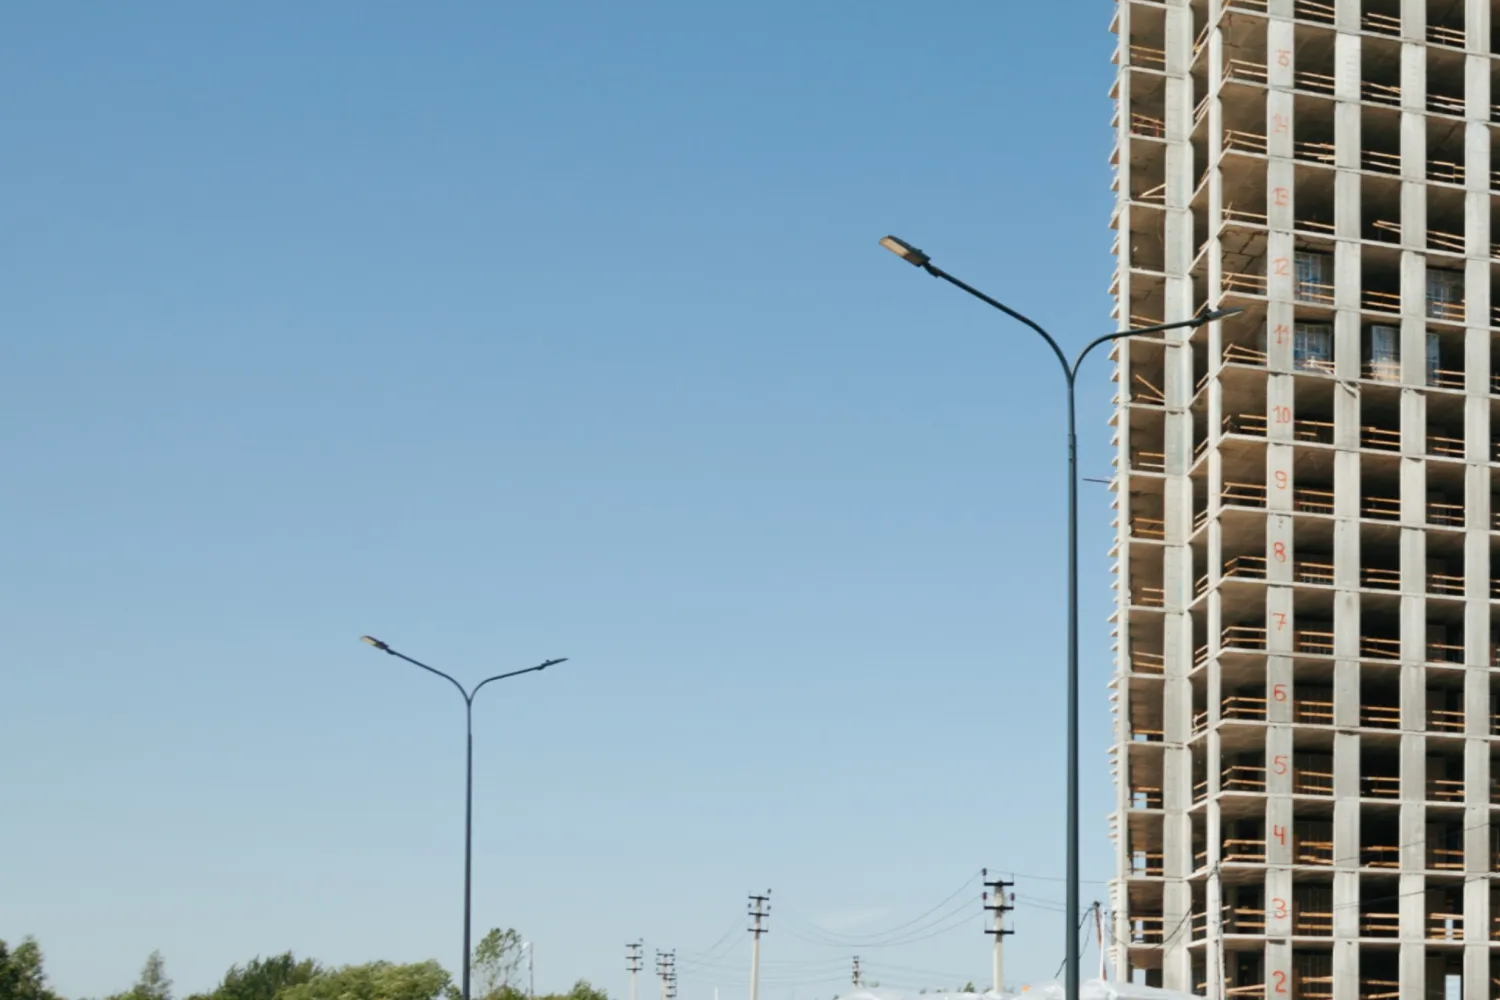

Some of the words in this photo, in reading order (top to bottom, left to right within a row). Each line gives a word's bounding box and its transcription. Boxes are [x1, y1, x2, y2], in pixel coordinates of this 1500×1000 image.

[1272, 257, 1289, 276] 12
[1272, 405, 1292, 424] 10
[1274, 470, 1288, 490] 9
[1272, 540, 1287, 563] 8
[1272, 613, 1287, 631] 7
[1273, 684, 1287, 702] 6
[1273, 755, 1289, 775] 5
[1273, 824, 1287, 846] 4
[1272, 897, 1288, 920] 3
[1272, 970, 1288, 993] 2
